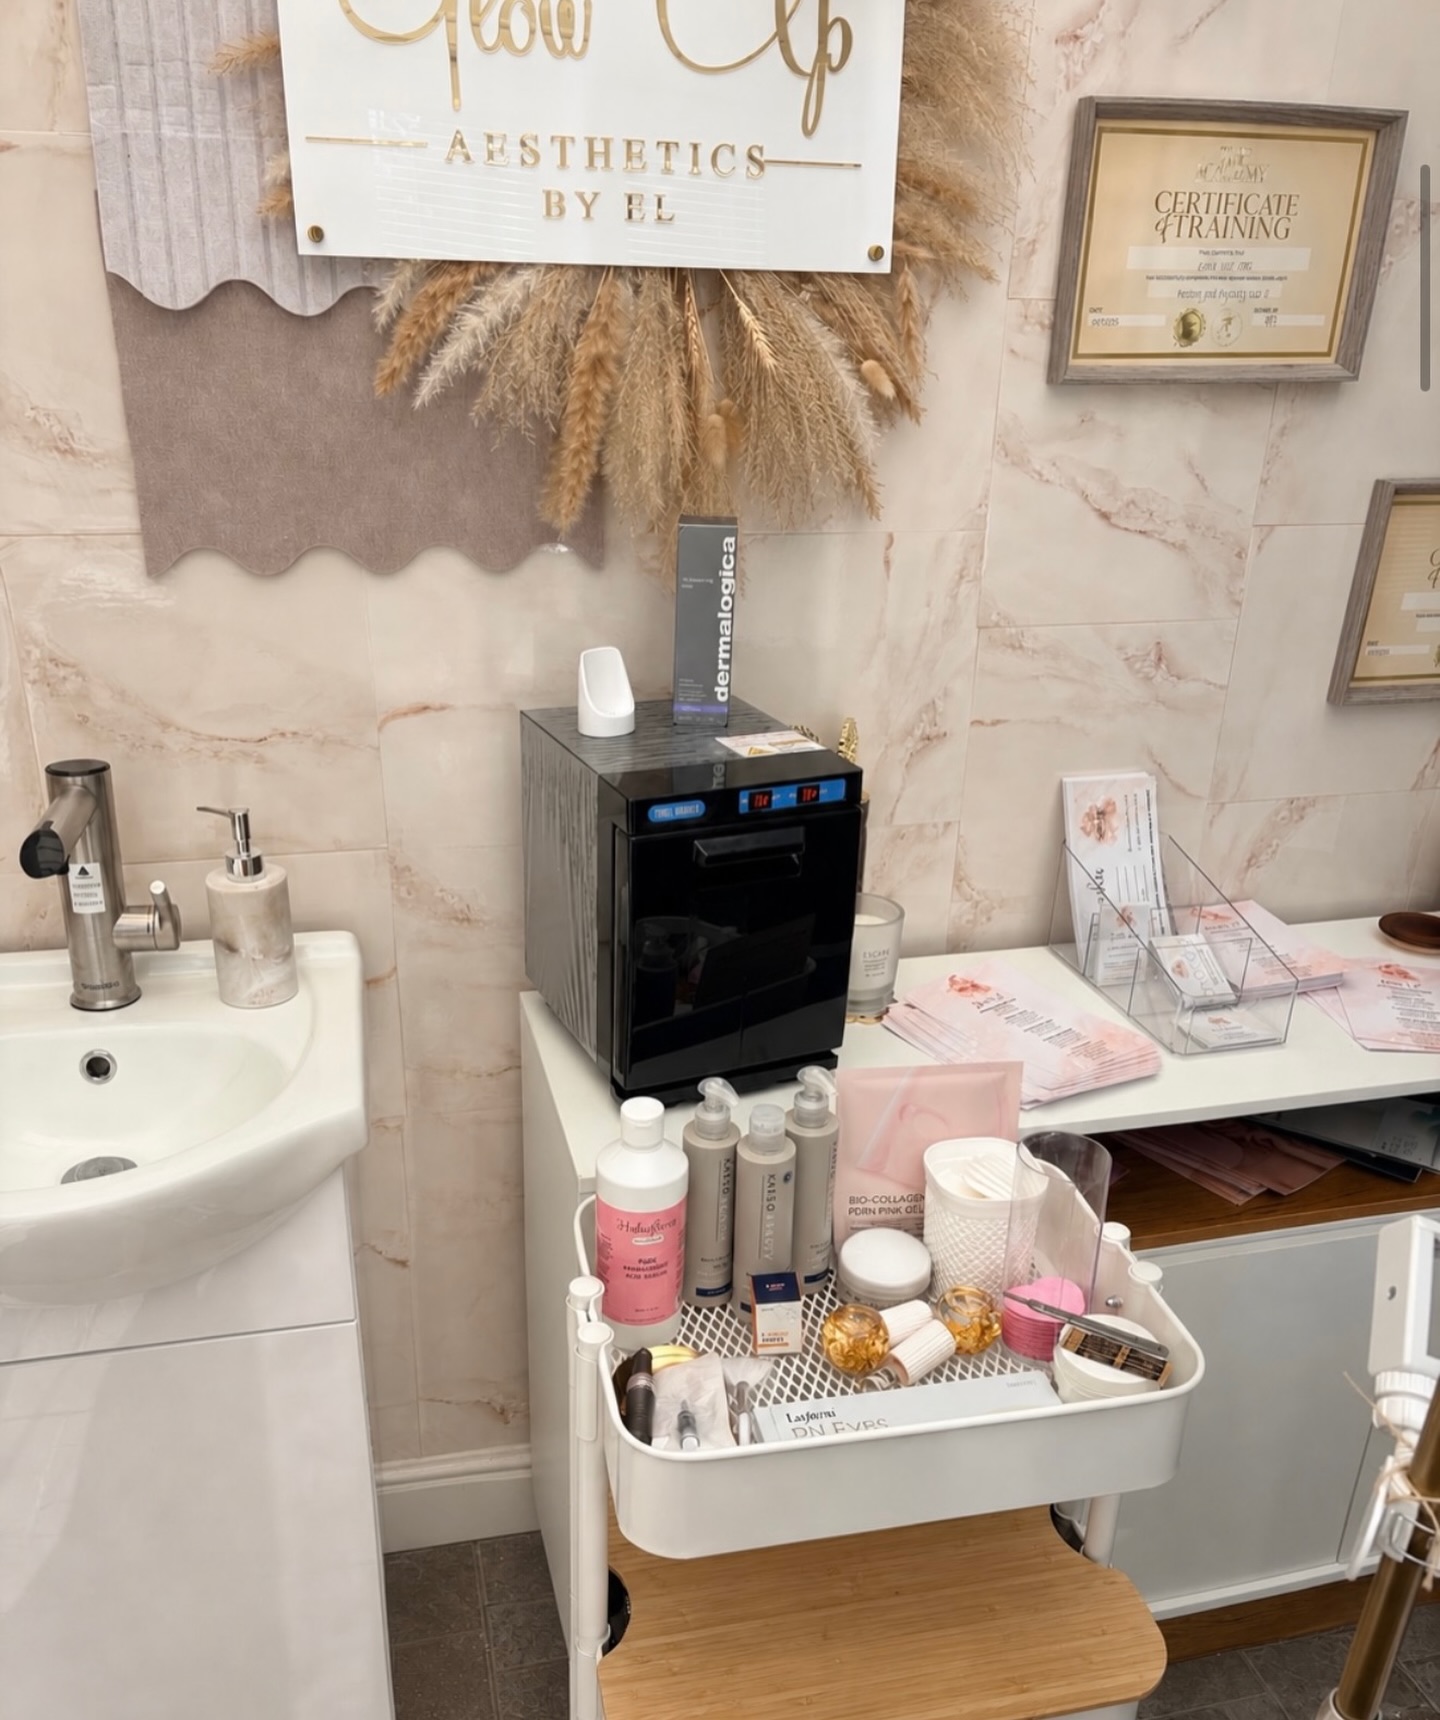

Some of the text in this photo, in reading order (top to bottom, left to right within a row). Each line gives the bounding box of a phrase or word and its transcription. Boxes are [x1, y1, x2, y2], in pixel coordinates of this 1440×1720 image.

[444, 129, 766, 179] AESTHETICS
[542, 189, 675, 222] BY EL
[1155, 190, 1300, 216] CERTIFICATE
[1154, 213, 1292, 244] of TRAINING
[714, 536, 736, 702] dermalogica
[878, 1205, 903, 1215] PINK
